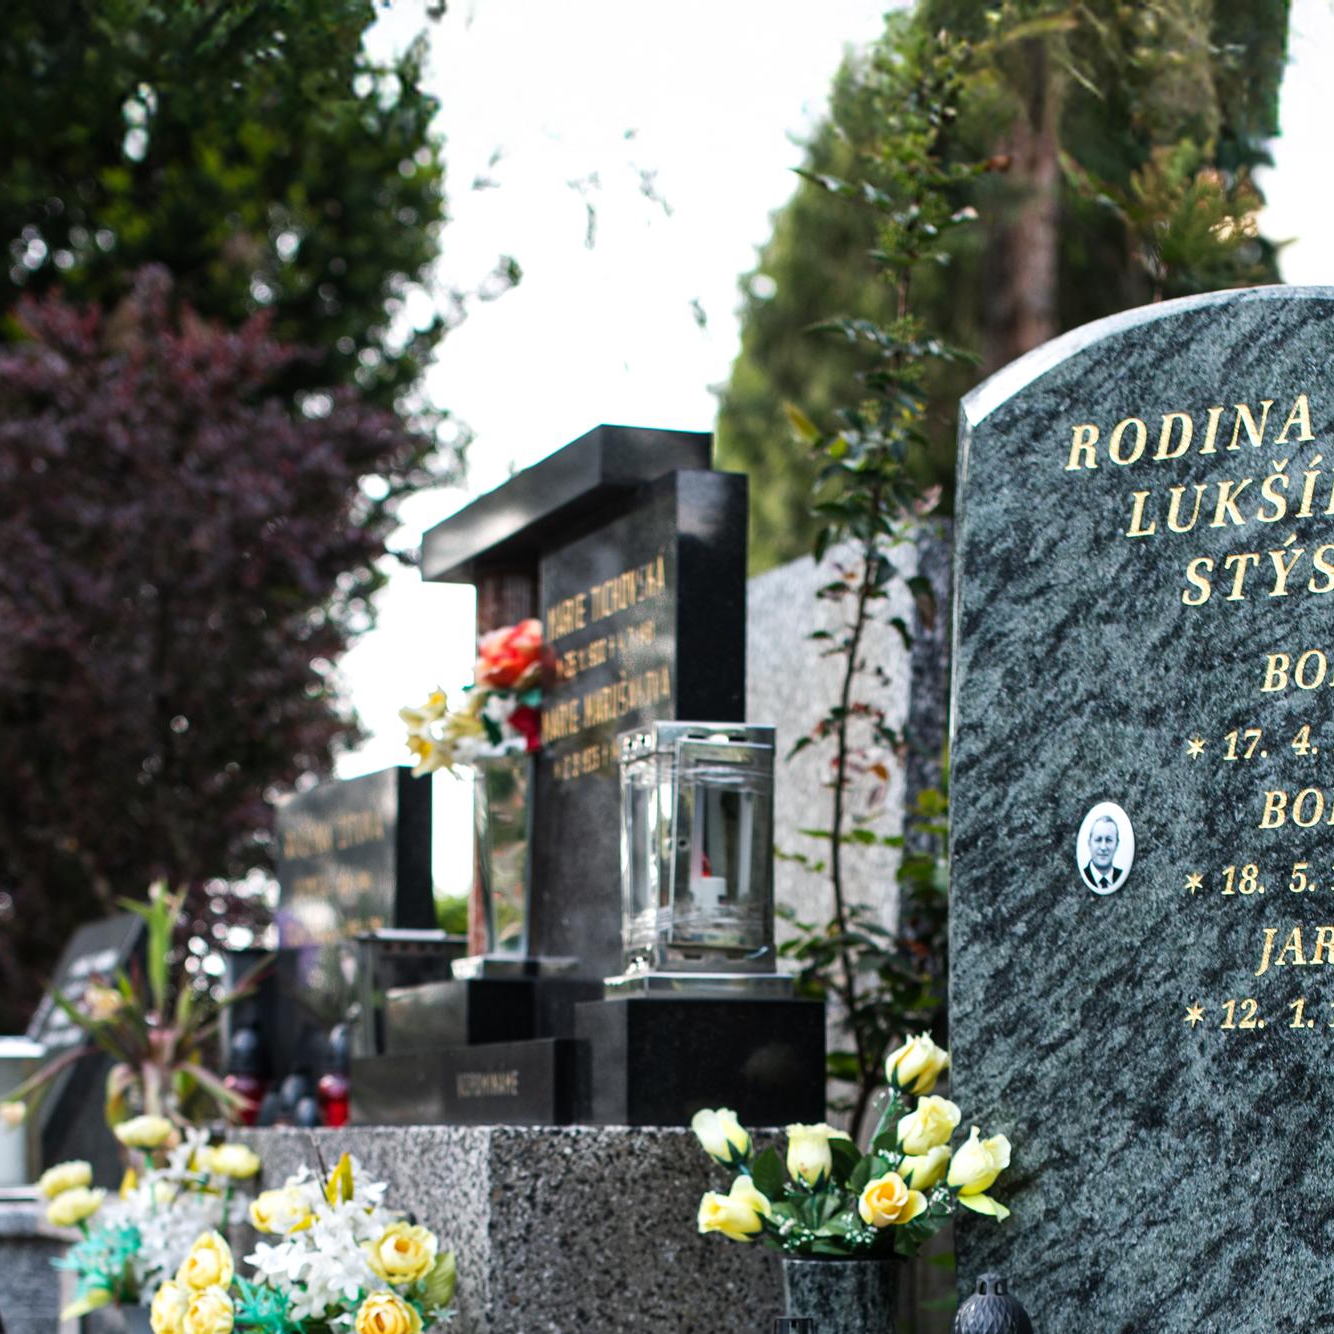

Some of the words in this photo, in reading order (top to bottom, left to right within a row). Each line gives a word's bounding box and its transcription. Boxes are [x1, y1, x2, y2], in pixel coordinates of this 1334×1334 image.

[1065, 393, 1317, 472] RODINA
[1223, 727, 1269, 760] 17.
[1291, 723, 1320, 756] 4.
[1221, 862, 1266, 896] 18.
[1290, 860, 1318, 893] 5.
[1220, 997, 1267, 1030] 12.
[1289, 996, 1316, 1029] 1.
